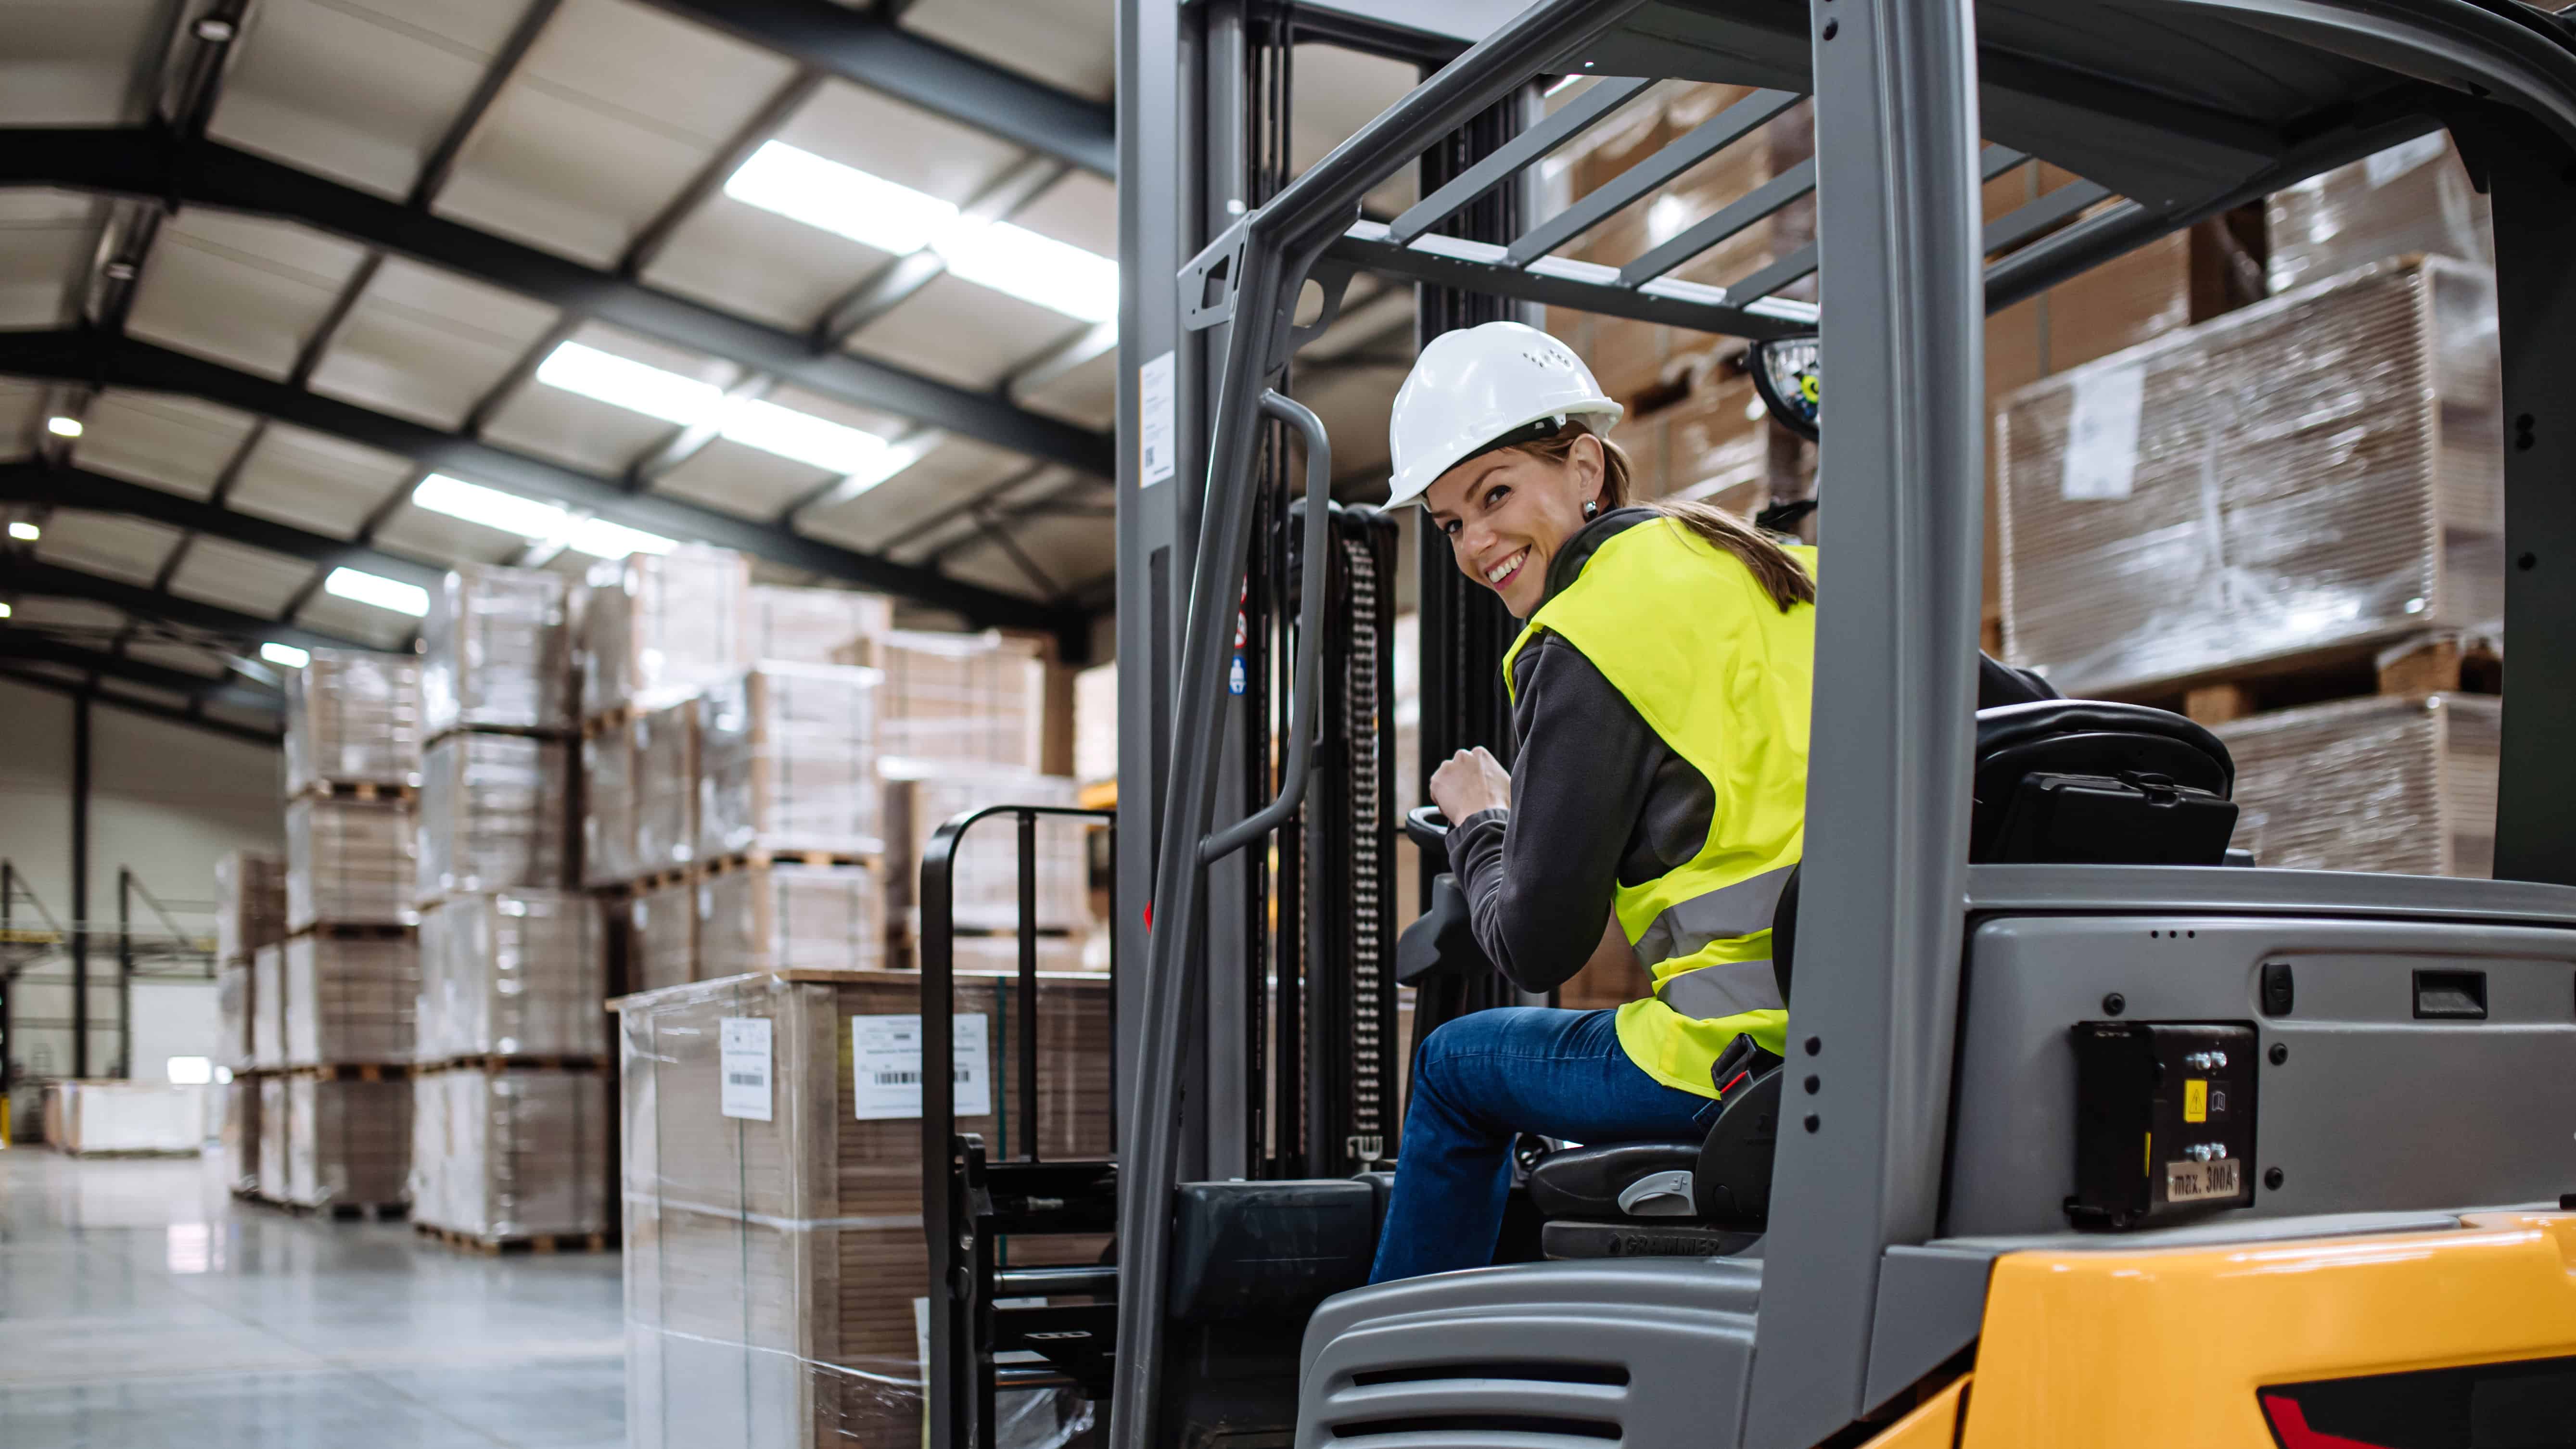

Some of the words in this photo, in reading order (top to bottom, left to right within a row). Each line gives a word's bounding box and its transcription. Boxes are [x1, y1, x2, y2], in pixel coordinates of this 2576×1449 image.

[2175, 1174, 2202, 1195] max.
[2206, 1164, 2233, 1193] 300A
[1626, 1234, 1720, 1256] GRAMMER
